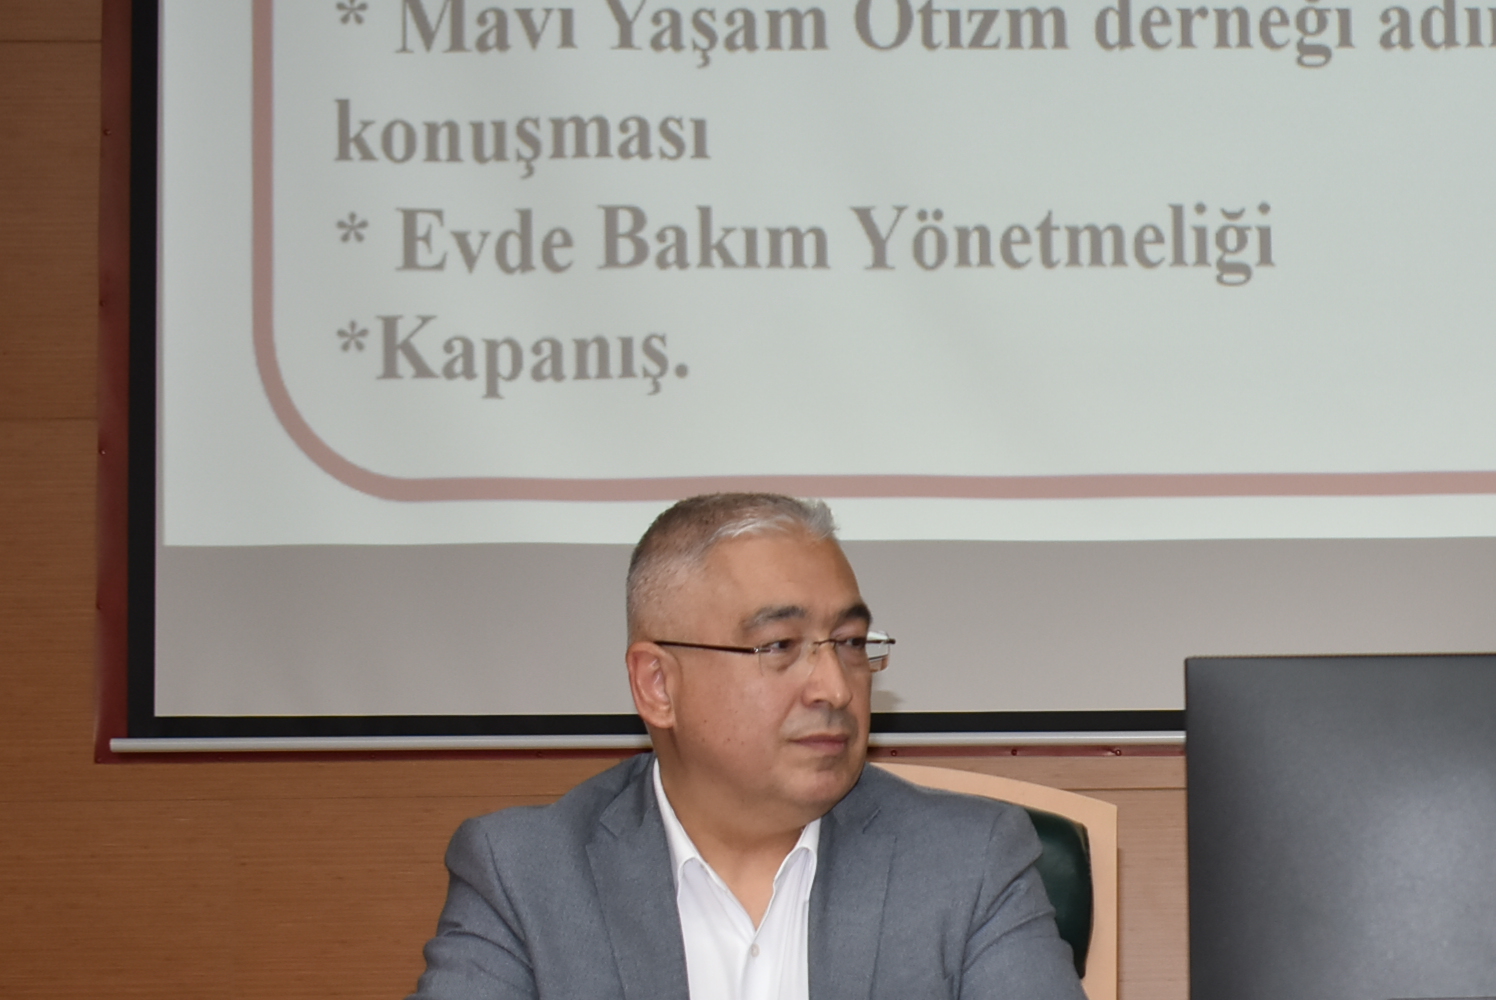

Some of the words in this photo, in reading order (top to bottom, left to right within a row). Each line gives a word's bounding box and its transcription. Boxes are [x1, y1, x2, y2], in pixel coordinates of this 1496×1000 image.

[604, 0, 829, 70] Yaşam
[334, 98, 711, 180] konuşması
[396, 207, 574, 276] Evde
[597, 204, 831, 271] Bakım
[849, 201, 1276, 288] Yönetmeliği
